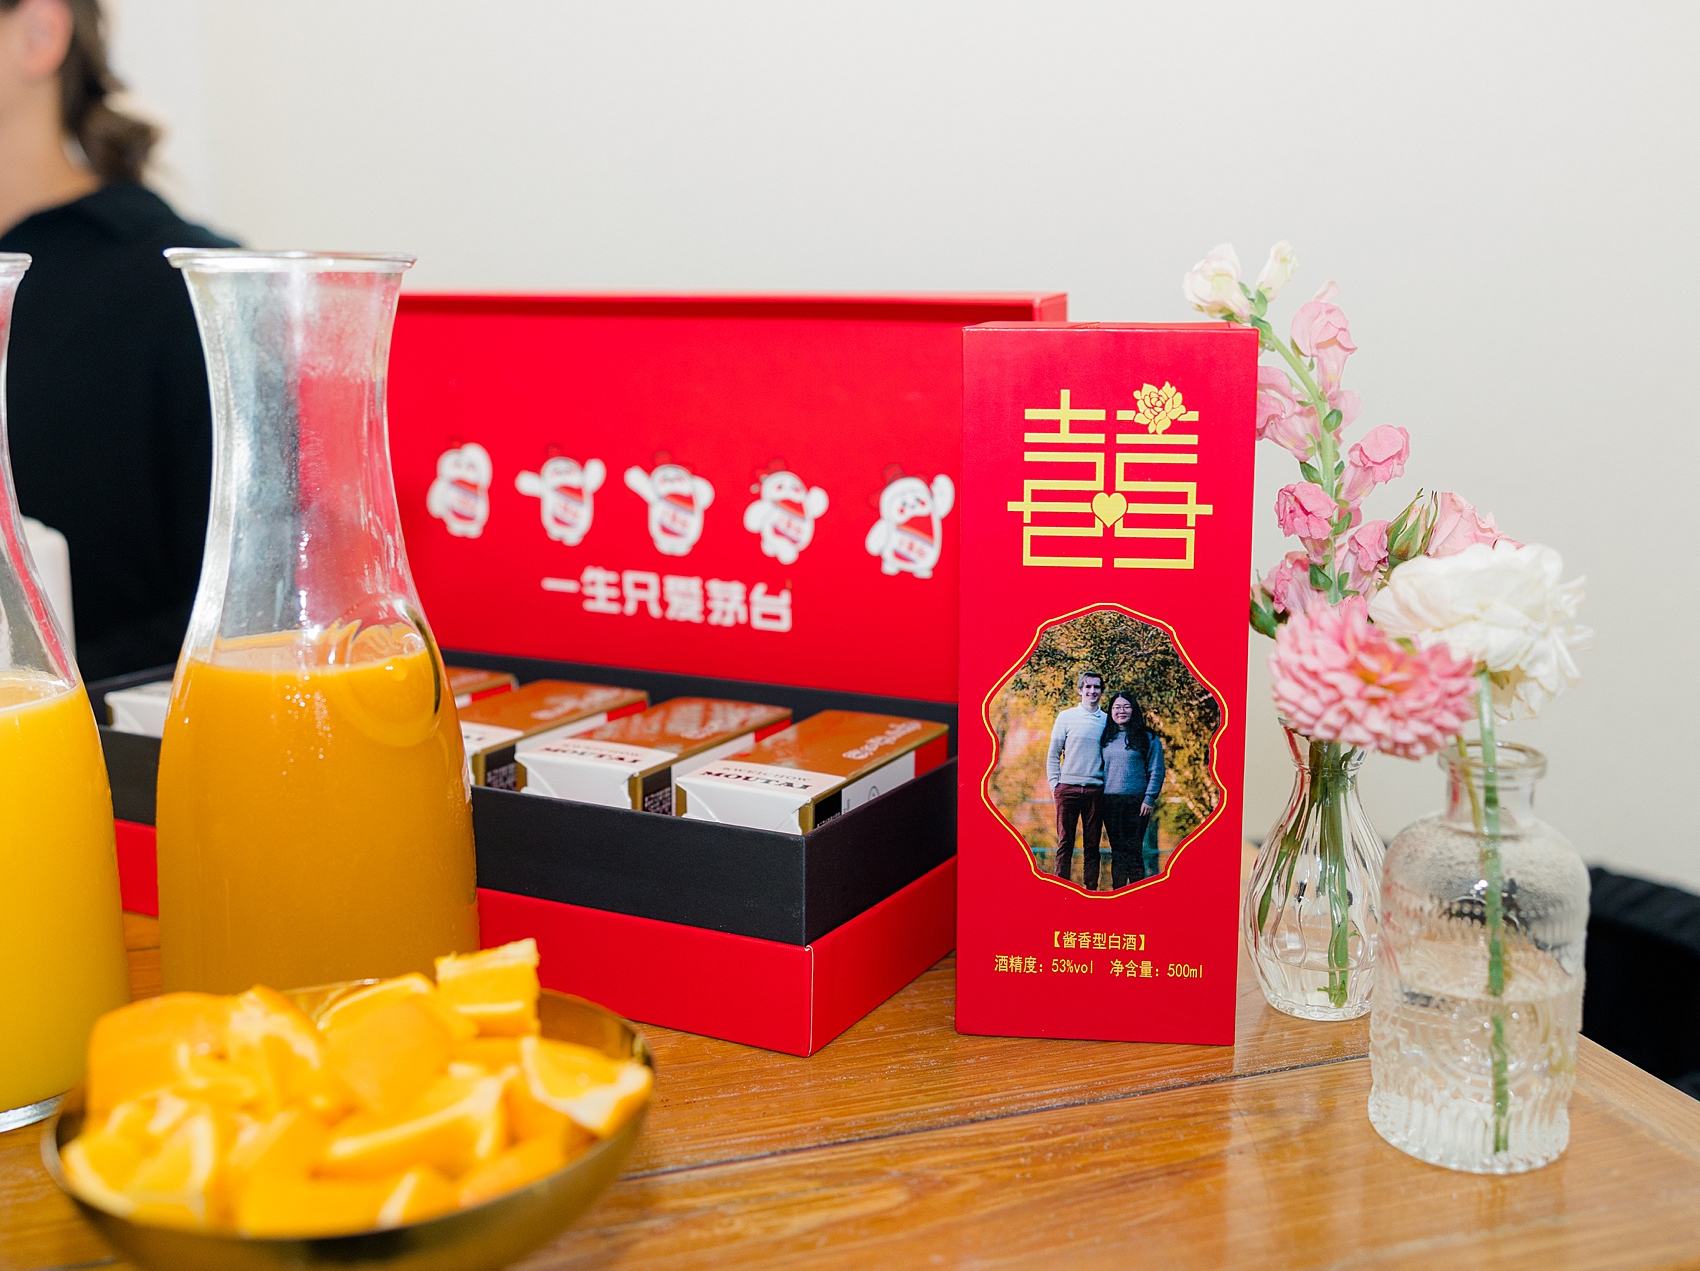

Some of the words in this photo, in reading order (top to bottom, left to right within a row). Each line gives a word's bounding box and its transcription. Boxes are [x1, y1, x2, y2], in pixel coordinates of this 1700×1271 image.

[540, 565, 793, 633] 一生只爱茅台
[699, 770, 813, 790] MOUTAI
